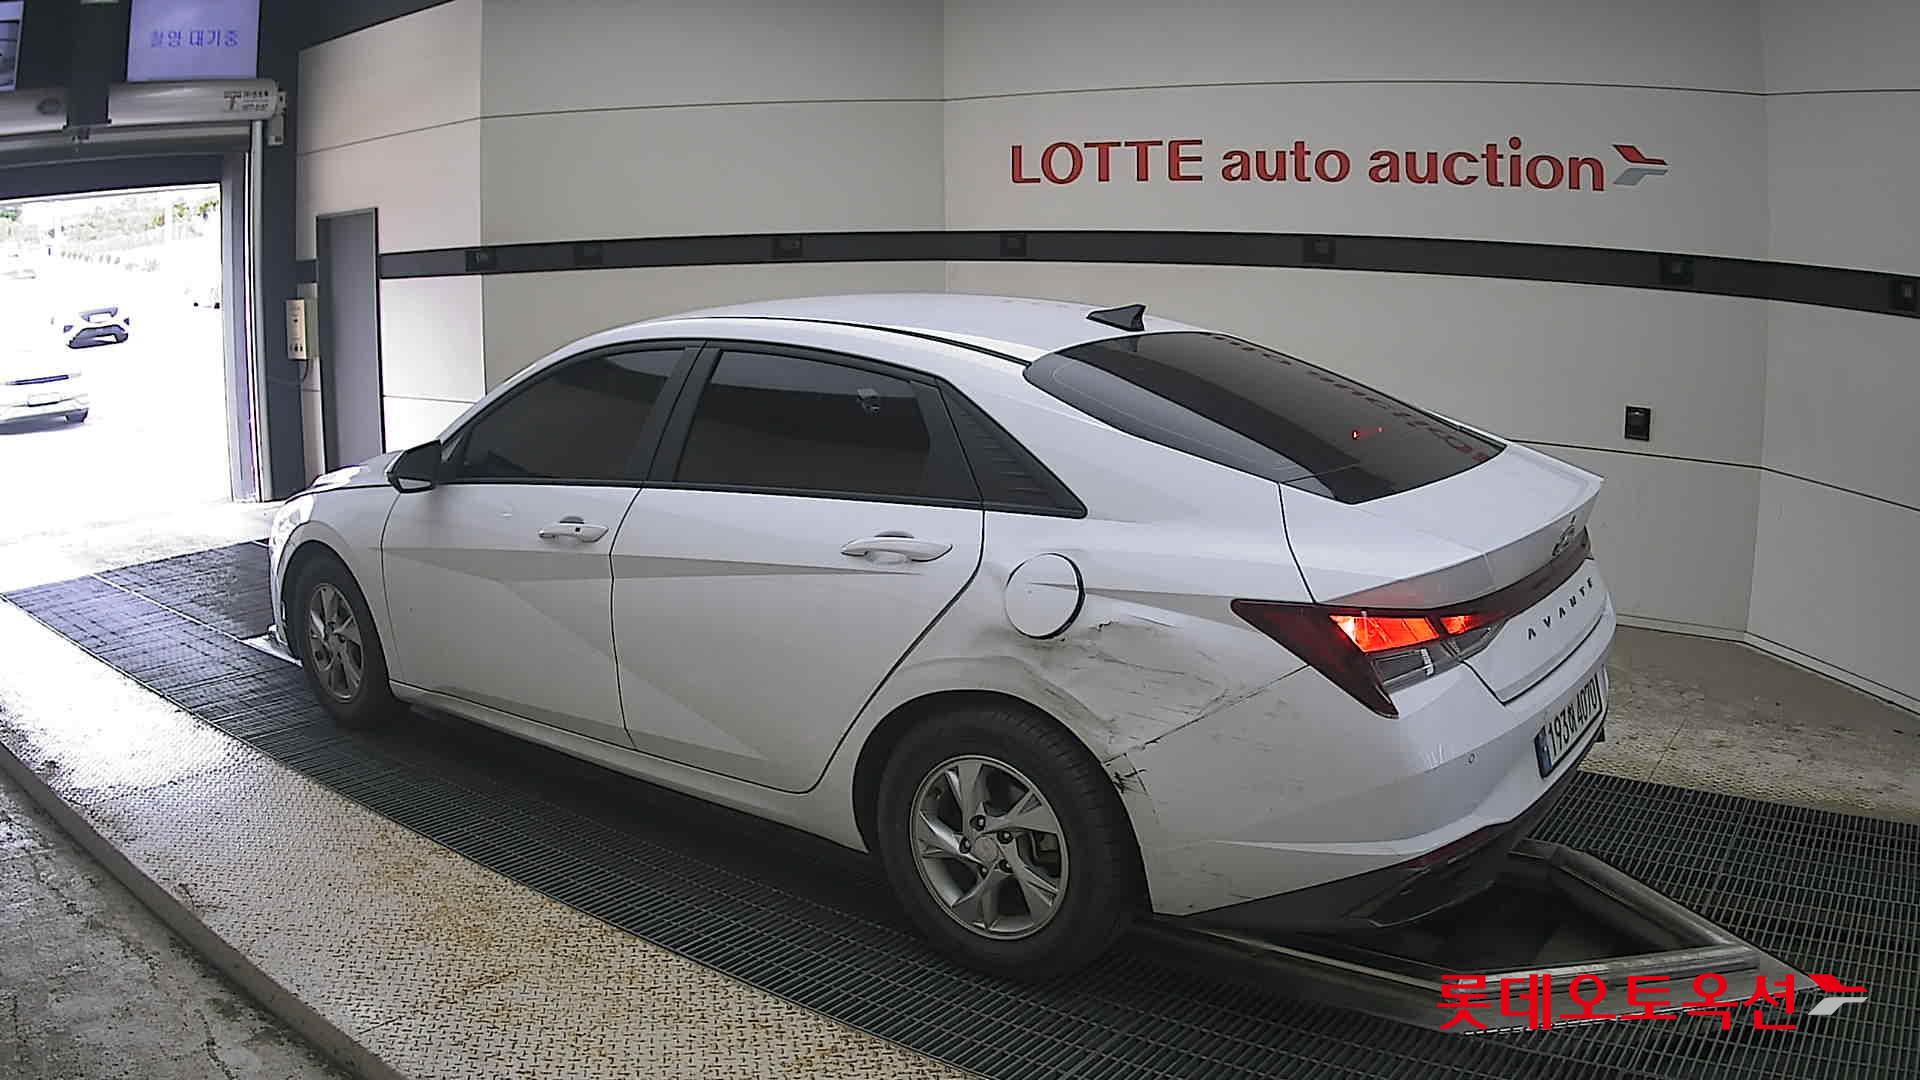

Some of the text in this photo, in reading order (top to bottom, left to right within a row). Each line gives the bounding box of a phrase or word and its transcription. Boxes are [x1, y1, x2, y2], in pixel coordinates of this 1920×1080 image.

[1010, 136, 1606, 192] LOTTE auto auction
[1527, 576, 1593, 640] AVANTE
